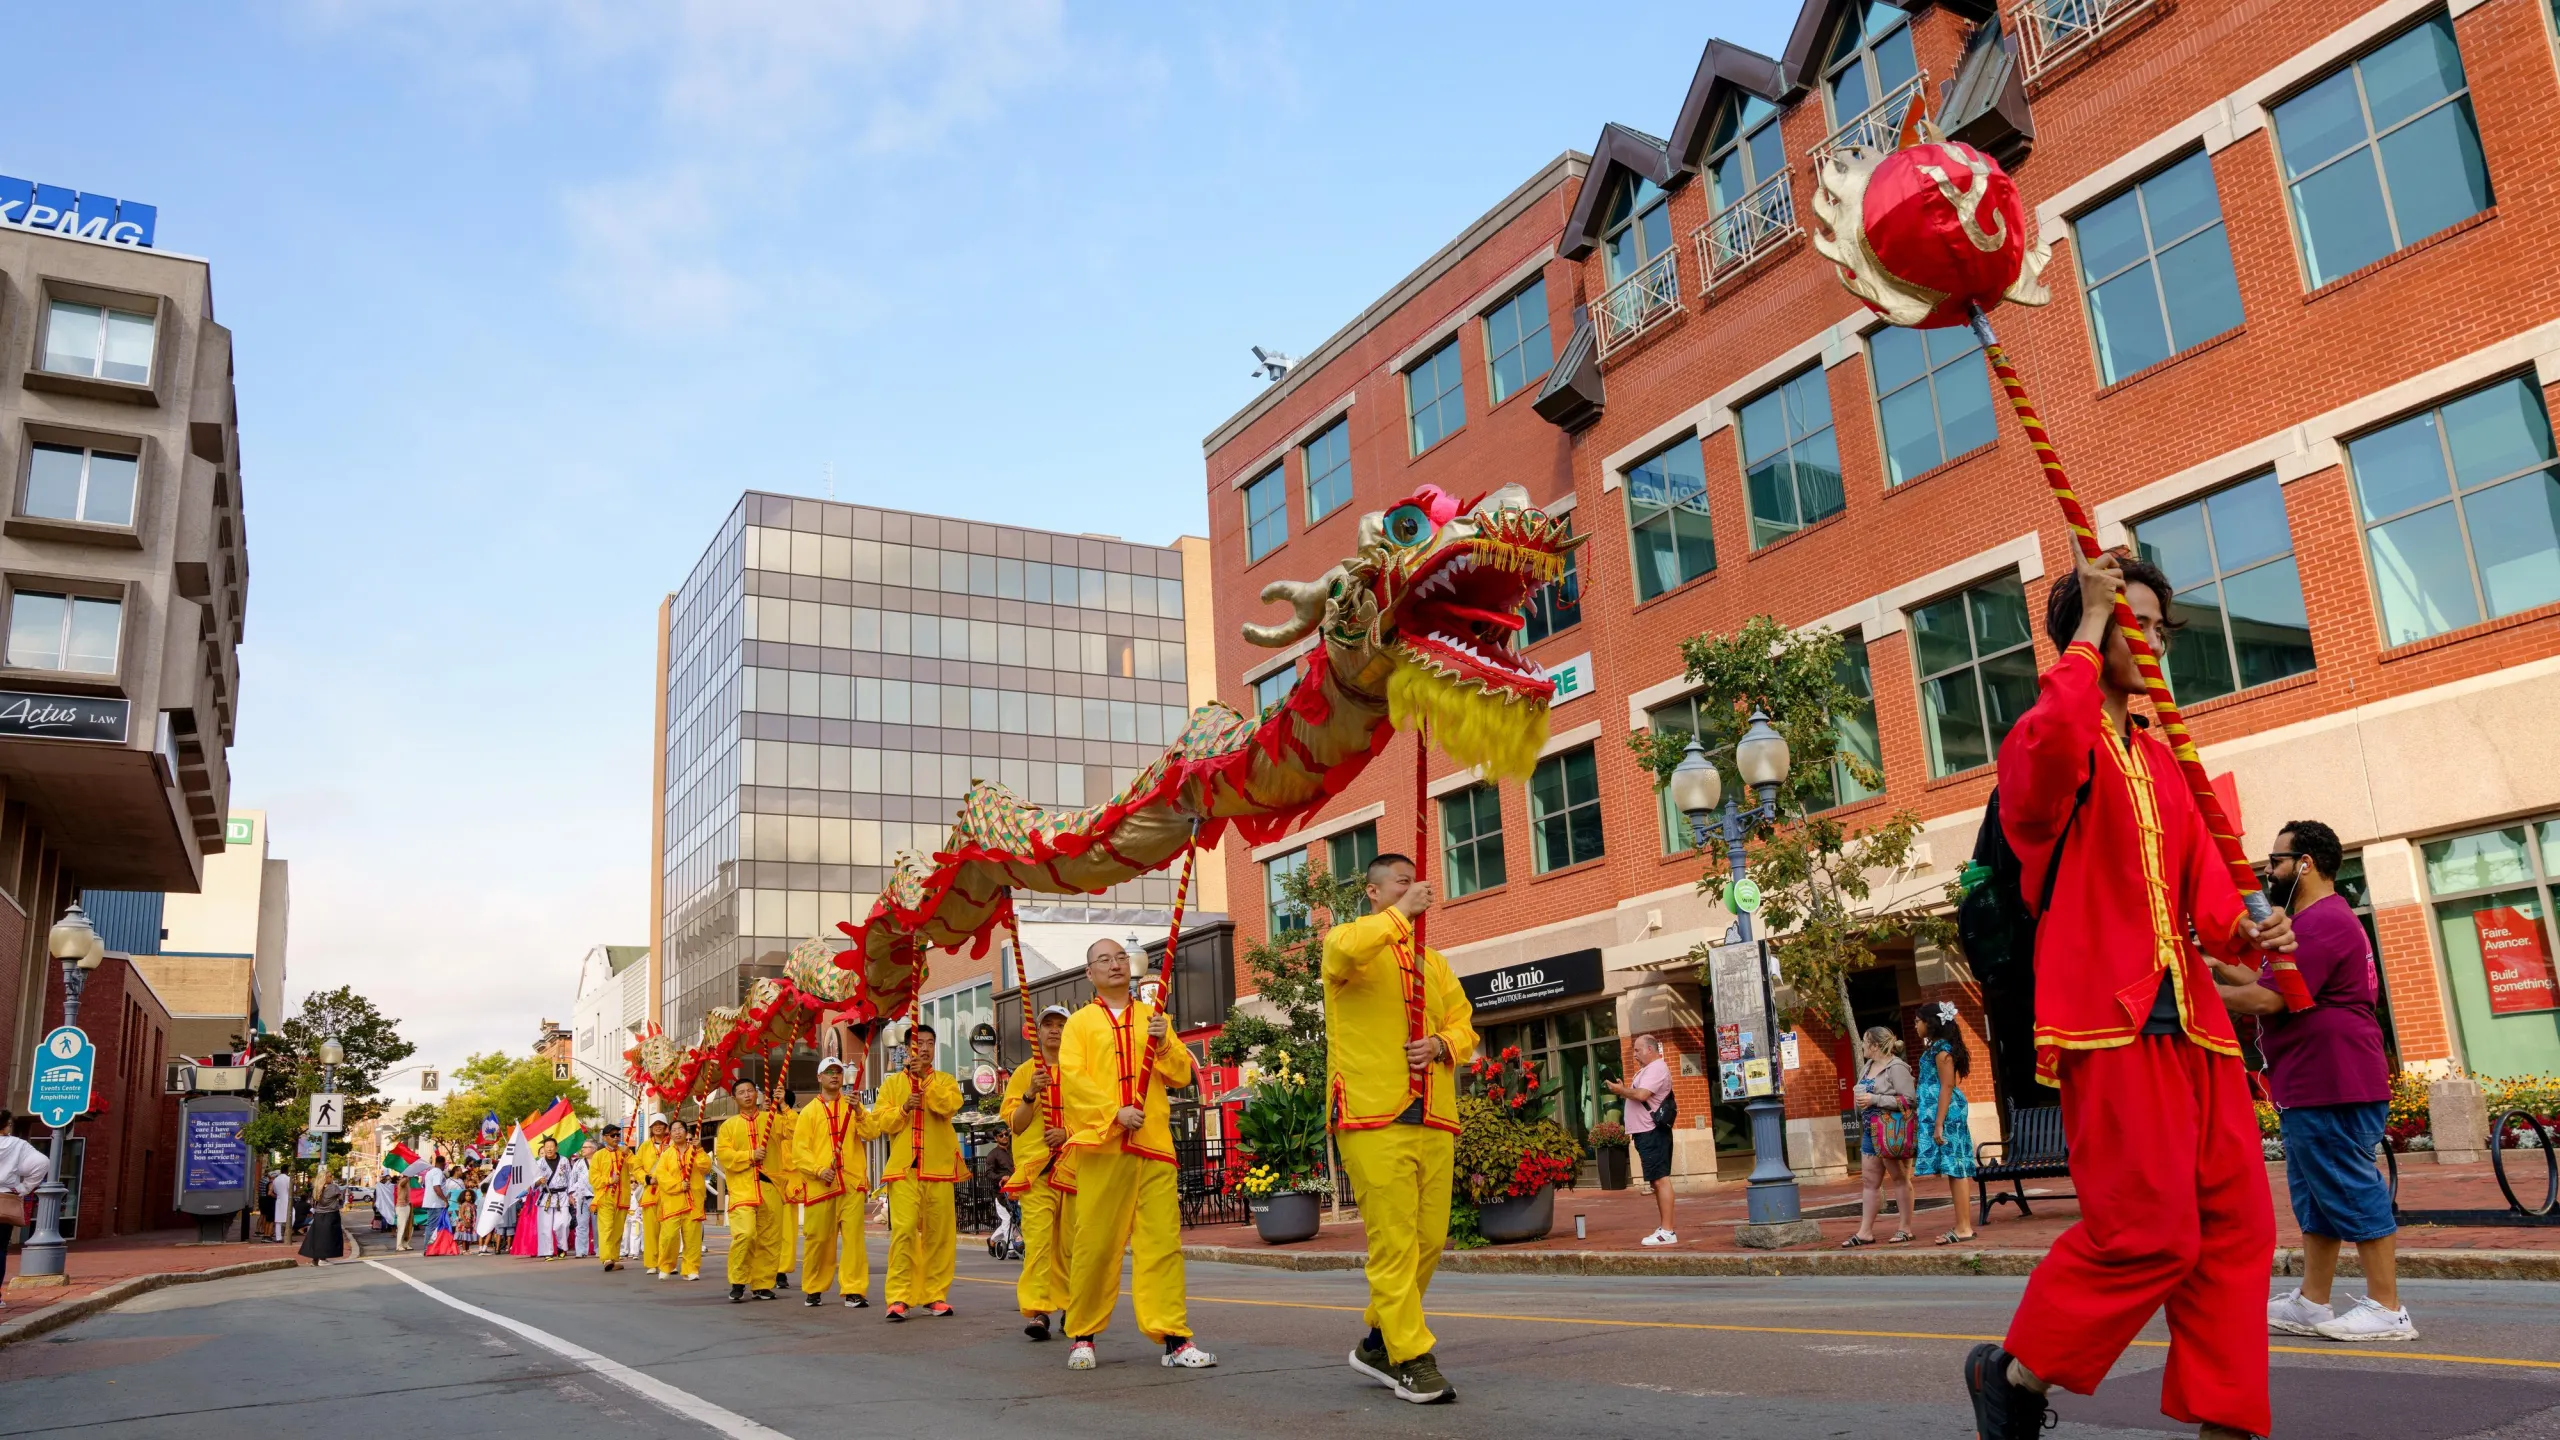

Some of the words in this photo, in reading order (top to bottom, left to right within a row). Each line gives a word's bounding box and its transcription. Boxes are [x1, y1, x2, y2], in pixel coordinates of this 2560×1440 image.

[0, 198, 143, 247] KPMG
[0, 698, 77, 725] Actus
[89, 714, 117, 724] LAW
[2482, 928, 2511, 938] Faire.
[2485, 937, 2531, 950] Avancer.
[1491, 972, 1513, 992] elle
[1517, 967, 1544, 988] mio
[2490, 968, 2518, 981] Build
[2493, 978, 2555, 992] something.
[1497, 993, 1522, 1004] BOUTIQUE
[1842, 1122, 1859, 1130] 6928
